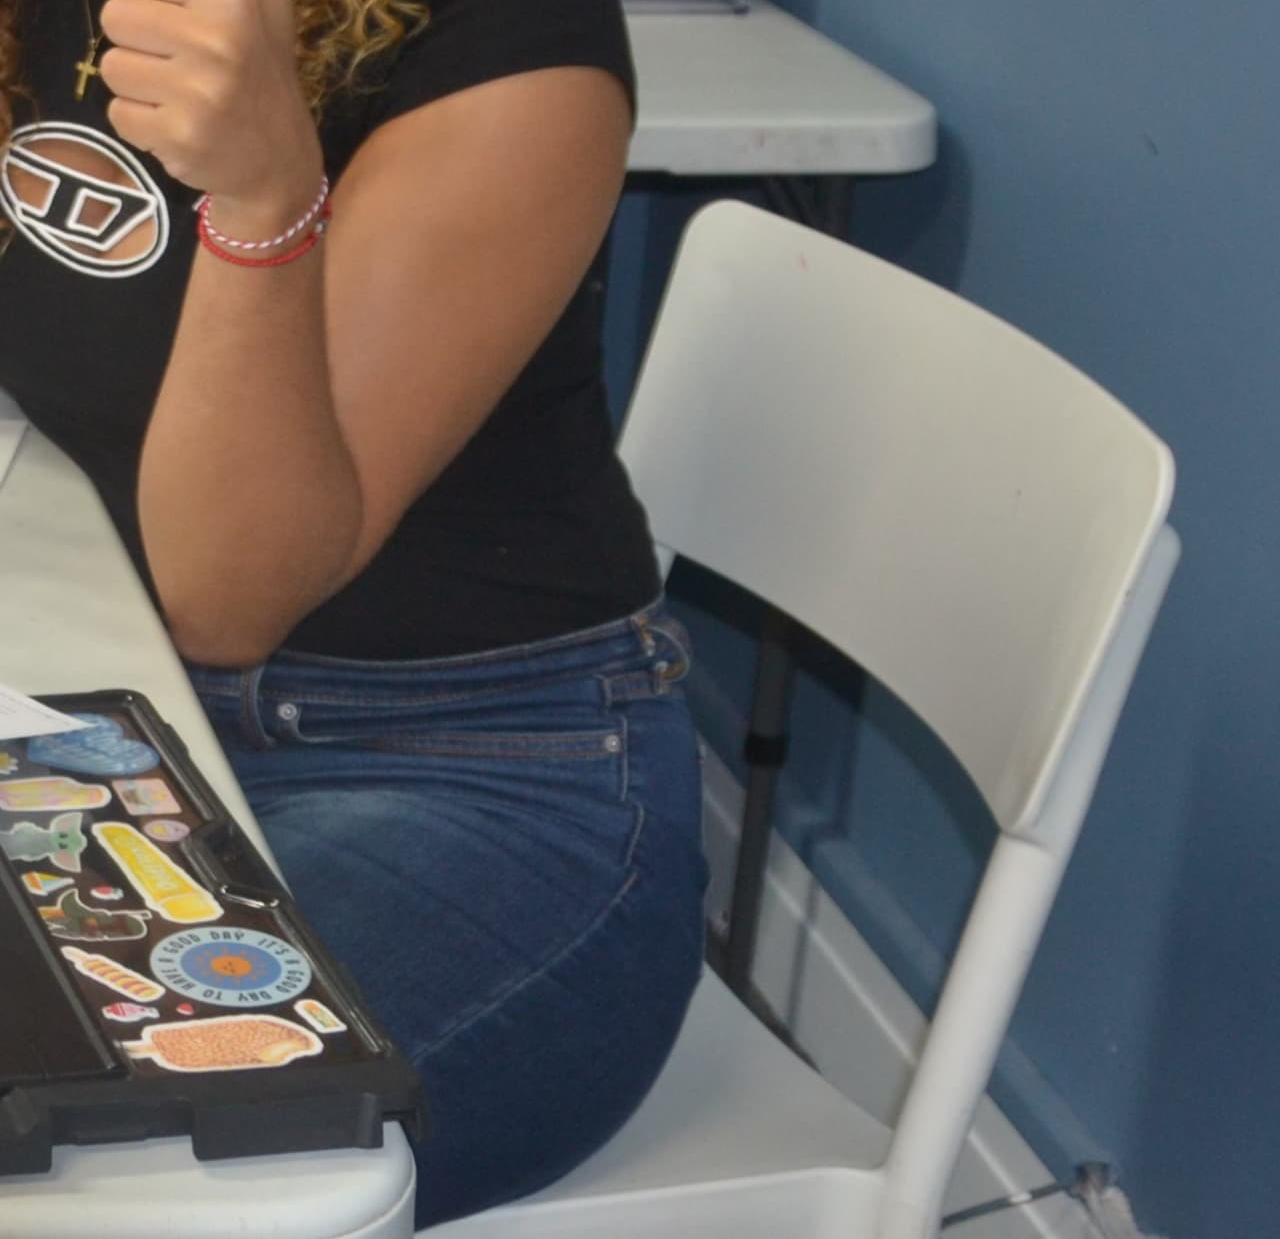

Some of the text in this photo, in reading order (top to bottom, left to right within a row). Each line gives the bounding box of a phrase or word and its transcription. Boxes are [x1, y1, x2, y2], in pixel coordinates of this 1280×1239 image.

[163, 933, 201, 955] GOOD
[209, 930, 245, 941] DAY
[161, 968, 196, 992] HAVE
[276, 970, 305, 993] GOOD
[202, 988, 223, 1000] TO
[237, 991, 273, 1002] DAY
